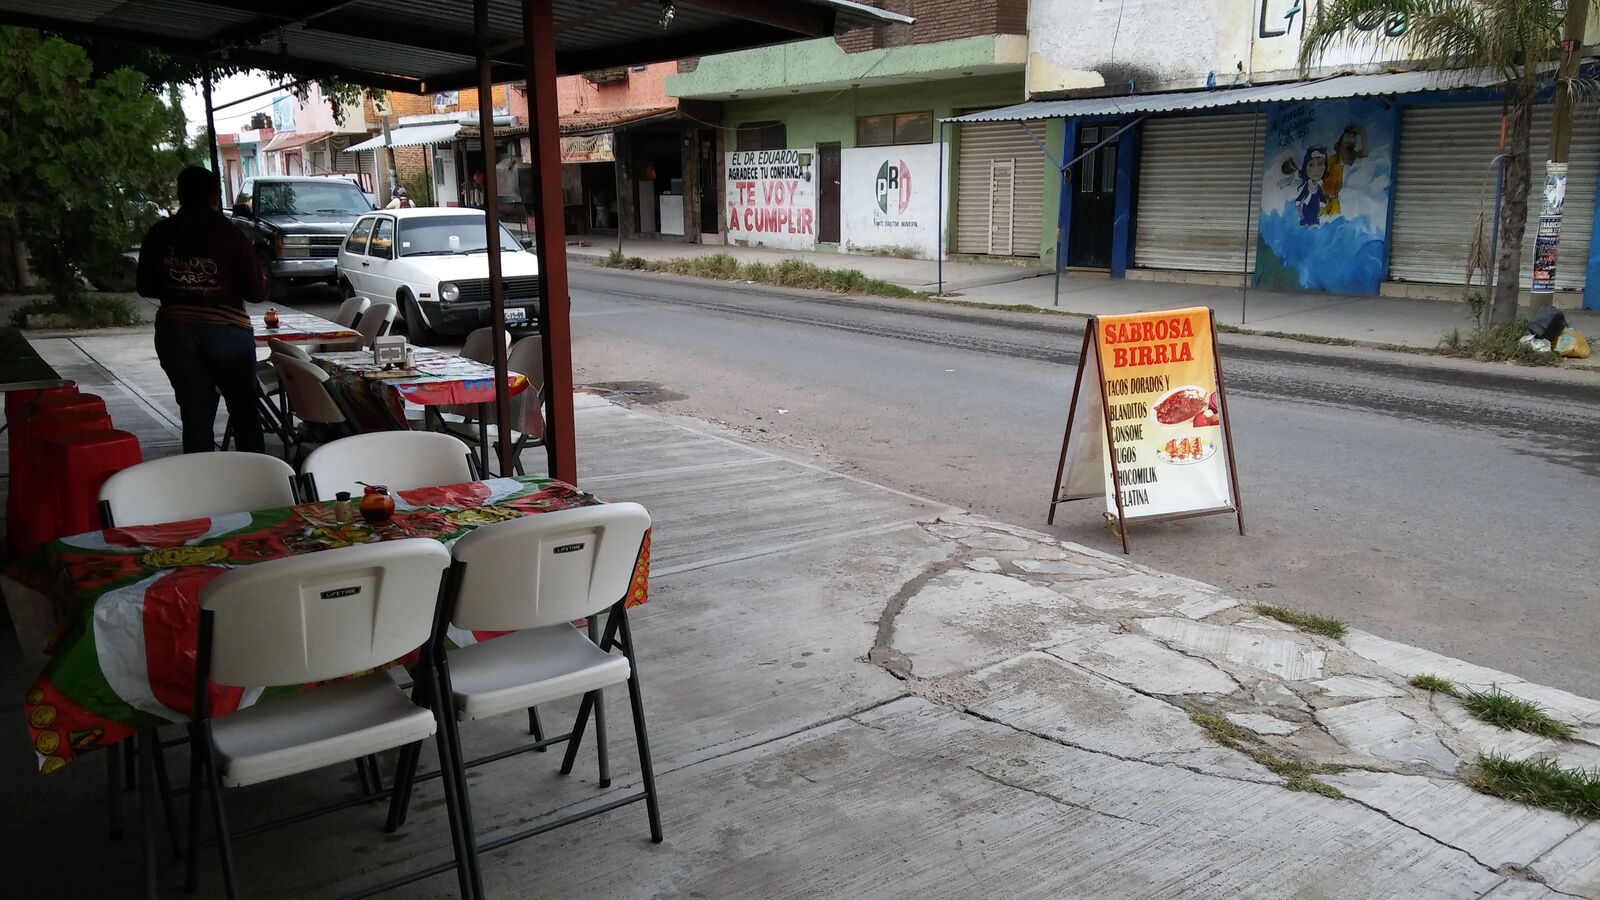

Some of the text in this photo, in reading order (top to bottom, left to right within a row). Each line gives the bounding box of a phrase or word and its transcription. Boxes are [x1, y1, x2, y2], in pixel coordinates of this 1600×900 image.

[732, 150, 799, 166] EL DR. EDUARDO
[729, 166, 804, 180] AGRADECE TU CONFIANZA
[736, 181, 799, 206] TE VOY
[878, 166, 907, 202] PRI
[729, 208, 814, 235] A CUMPLIR
[1104, 317, 1194, 345] SABROSA
[1113, 341, 1195, 368] BIRRIA
[1107, 375, 1170, 397] TACOS DORADOS Y
[1109, 401, 1148, 421] BLANDITOS
[1115, 446, 1137, 464] UGOS
[1117, 466, 1158, 487] HOCOMILIK
[1120, 488, 1150, 507] ELATINA
